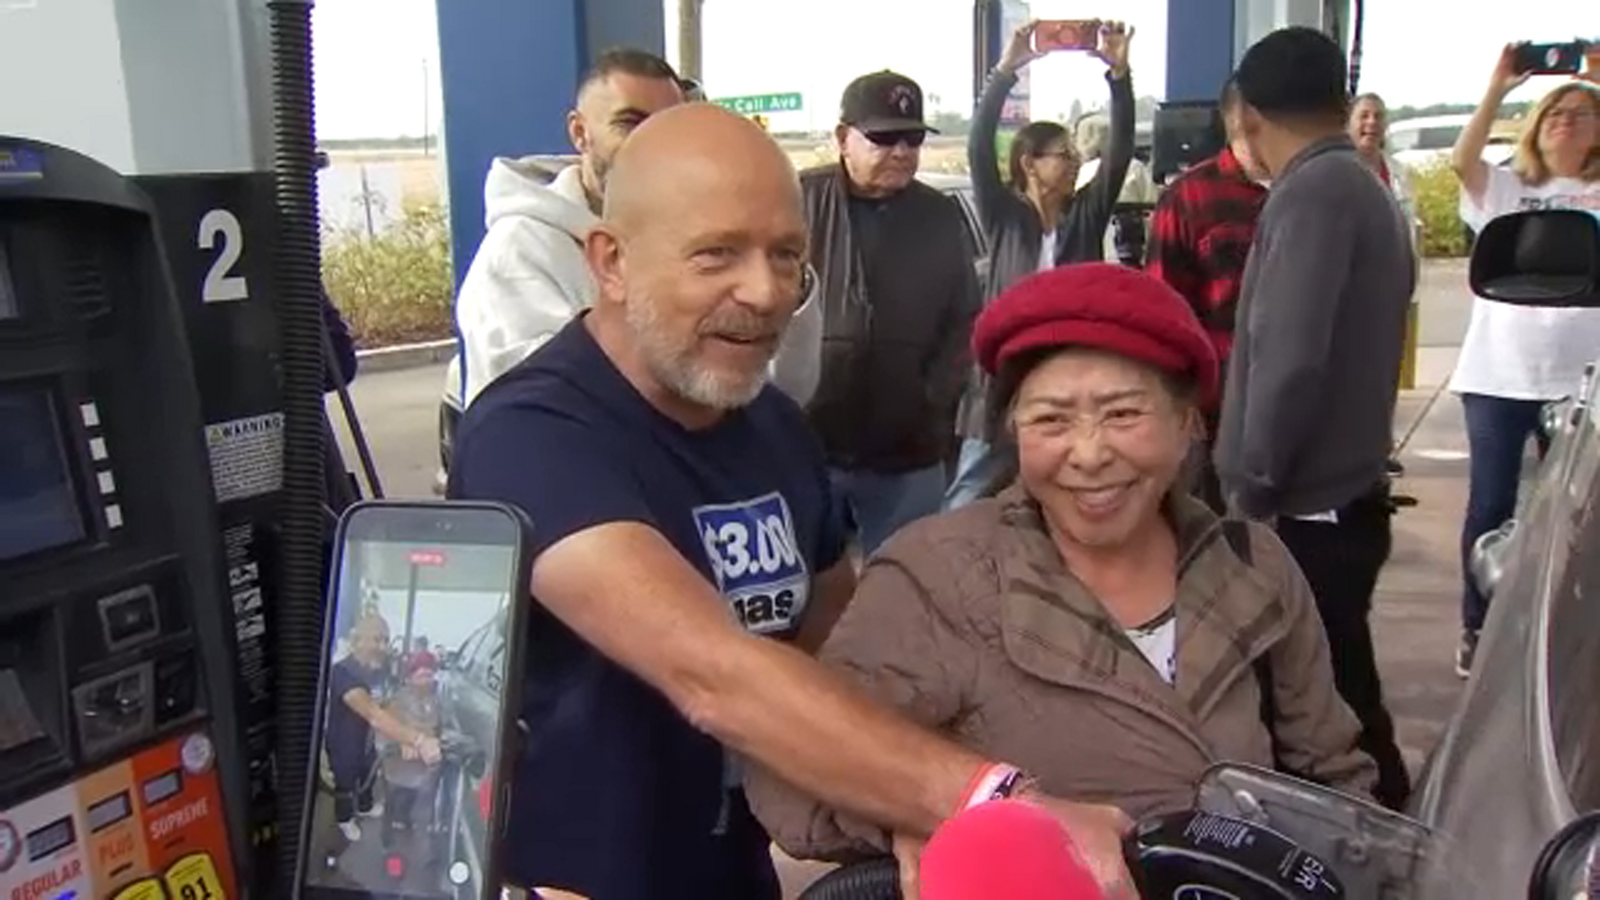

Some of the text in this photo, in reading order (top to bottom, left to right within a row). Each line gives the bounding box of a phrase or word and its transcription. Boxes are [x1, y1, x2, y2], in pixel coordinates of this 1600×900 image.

[769, 95, 796, 109] Ave
[198, 208, 249, 302] 2
[222, 415, 281, 438] WARNING
[150, 797, 209, 840] SUPREME
[98, 834, 136, 865] PLUS
[10, 858, 83, 900] REGULAR
[180, 876, 212, 900] 91
